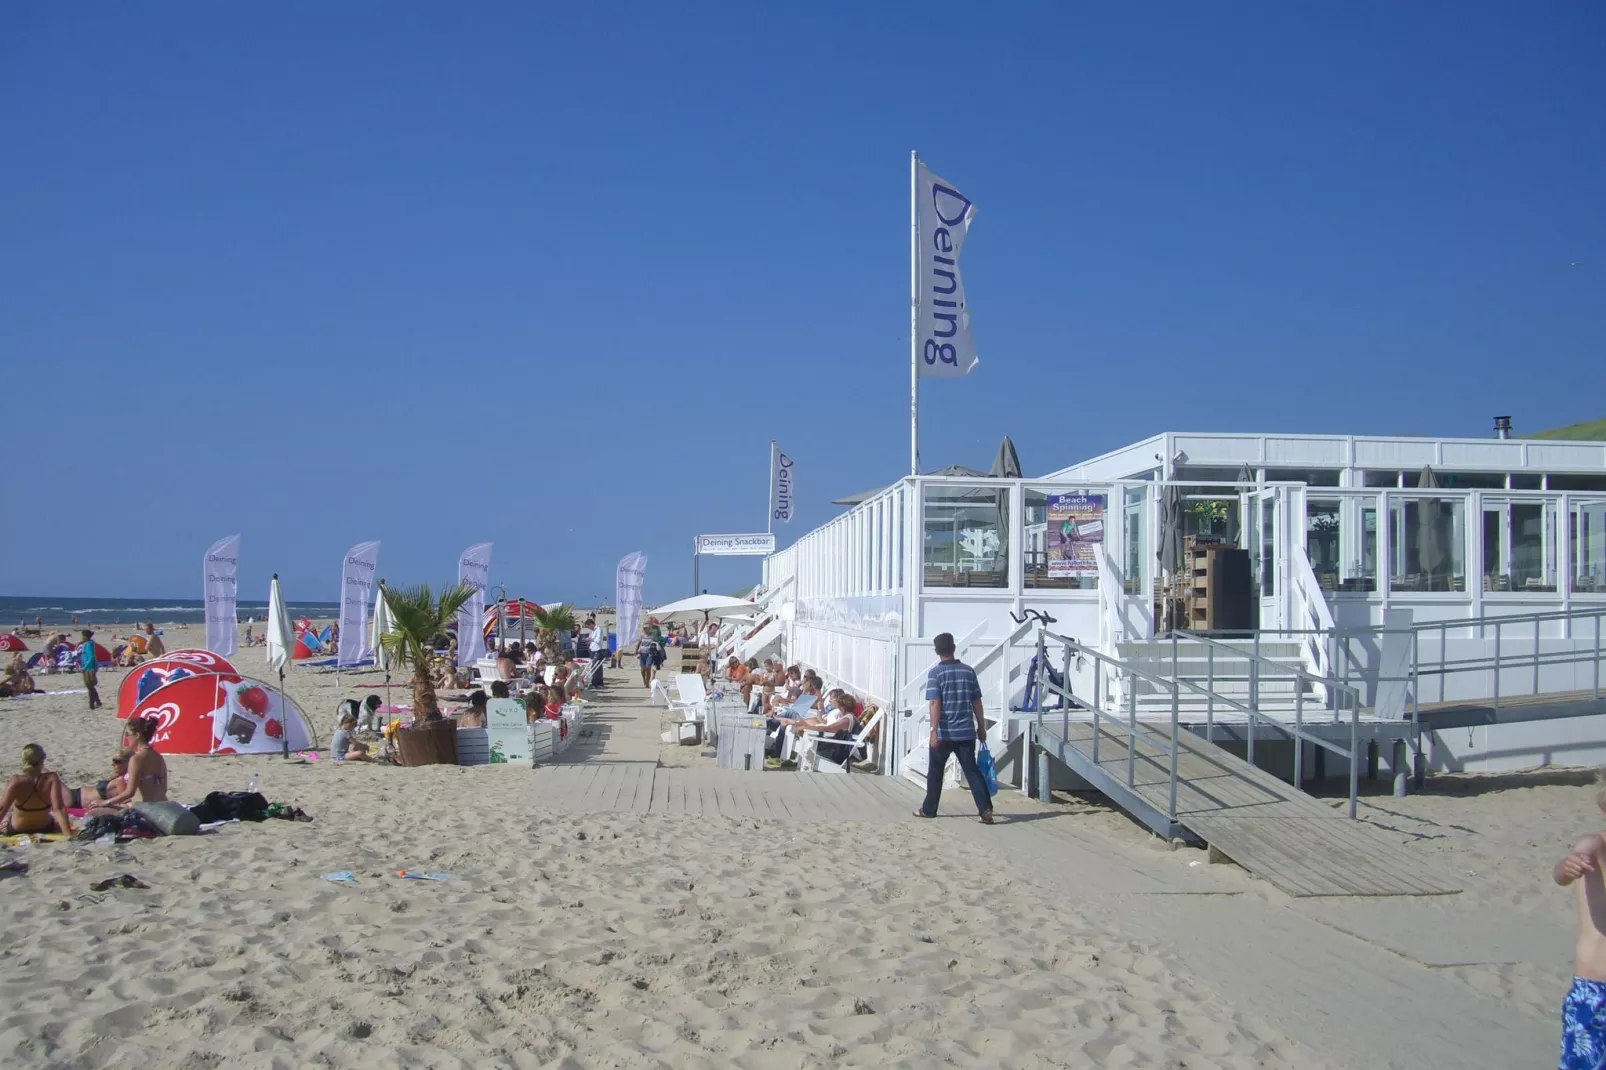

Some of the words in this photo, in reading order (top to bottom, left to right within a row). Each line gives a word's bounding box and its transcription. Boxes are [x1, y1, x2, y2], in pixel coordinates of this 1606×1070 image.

[924, 183, 972, 367] Deining
[774, 453, 794, 520] Deining
[1052, 503, 1096, 511] Spinning!
[703, 538, 733, 547] Deining
[208, 554, 237, 565] Deining
[348, 556, 375, 570] Deining
[463, 559, 489, 572] Deining
[208, 574, 236, 585] Deining
